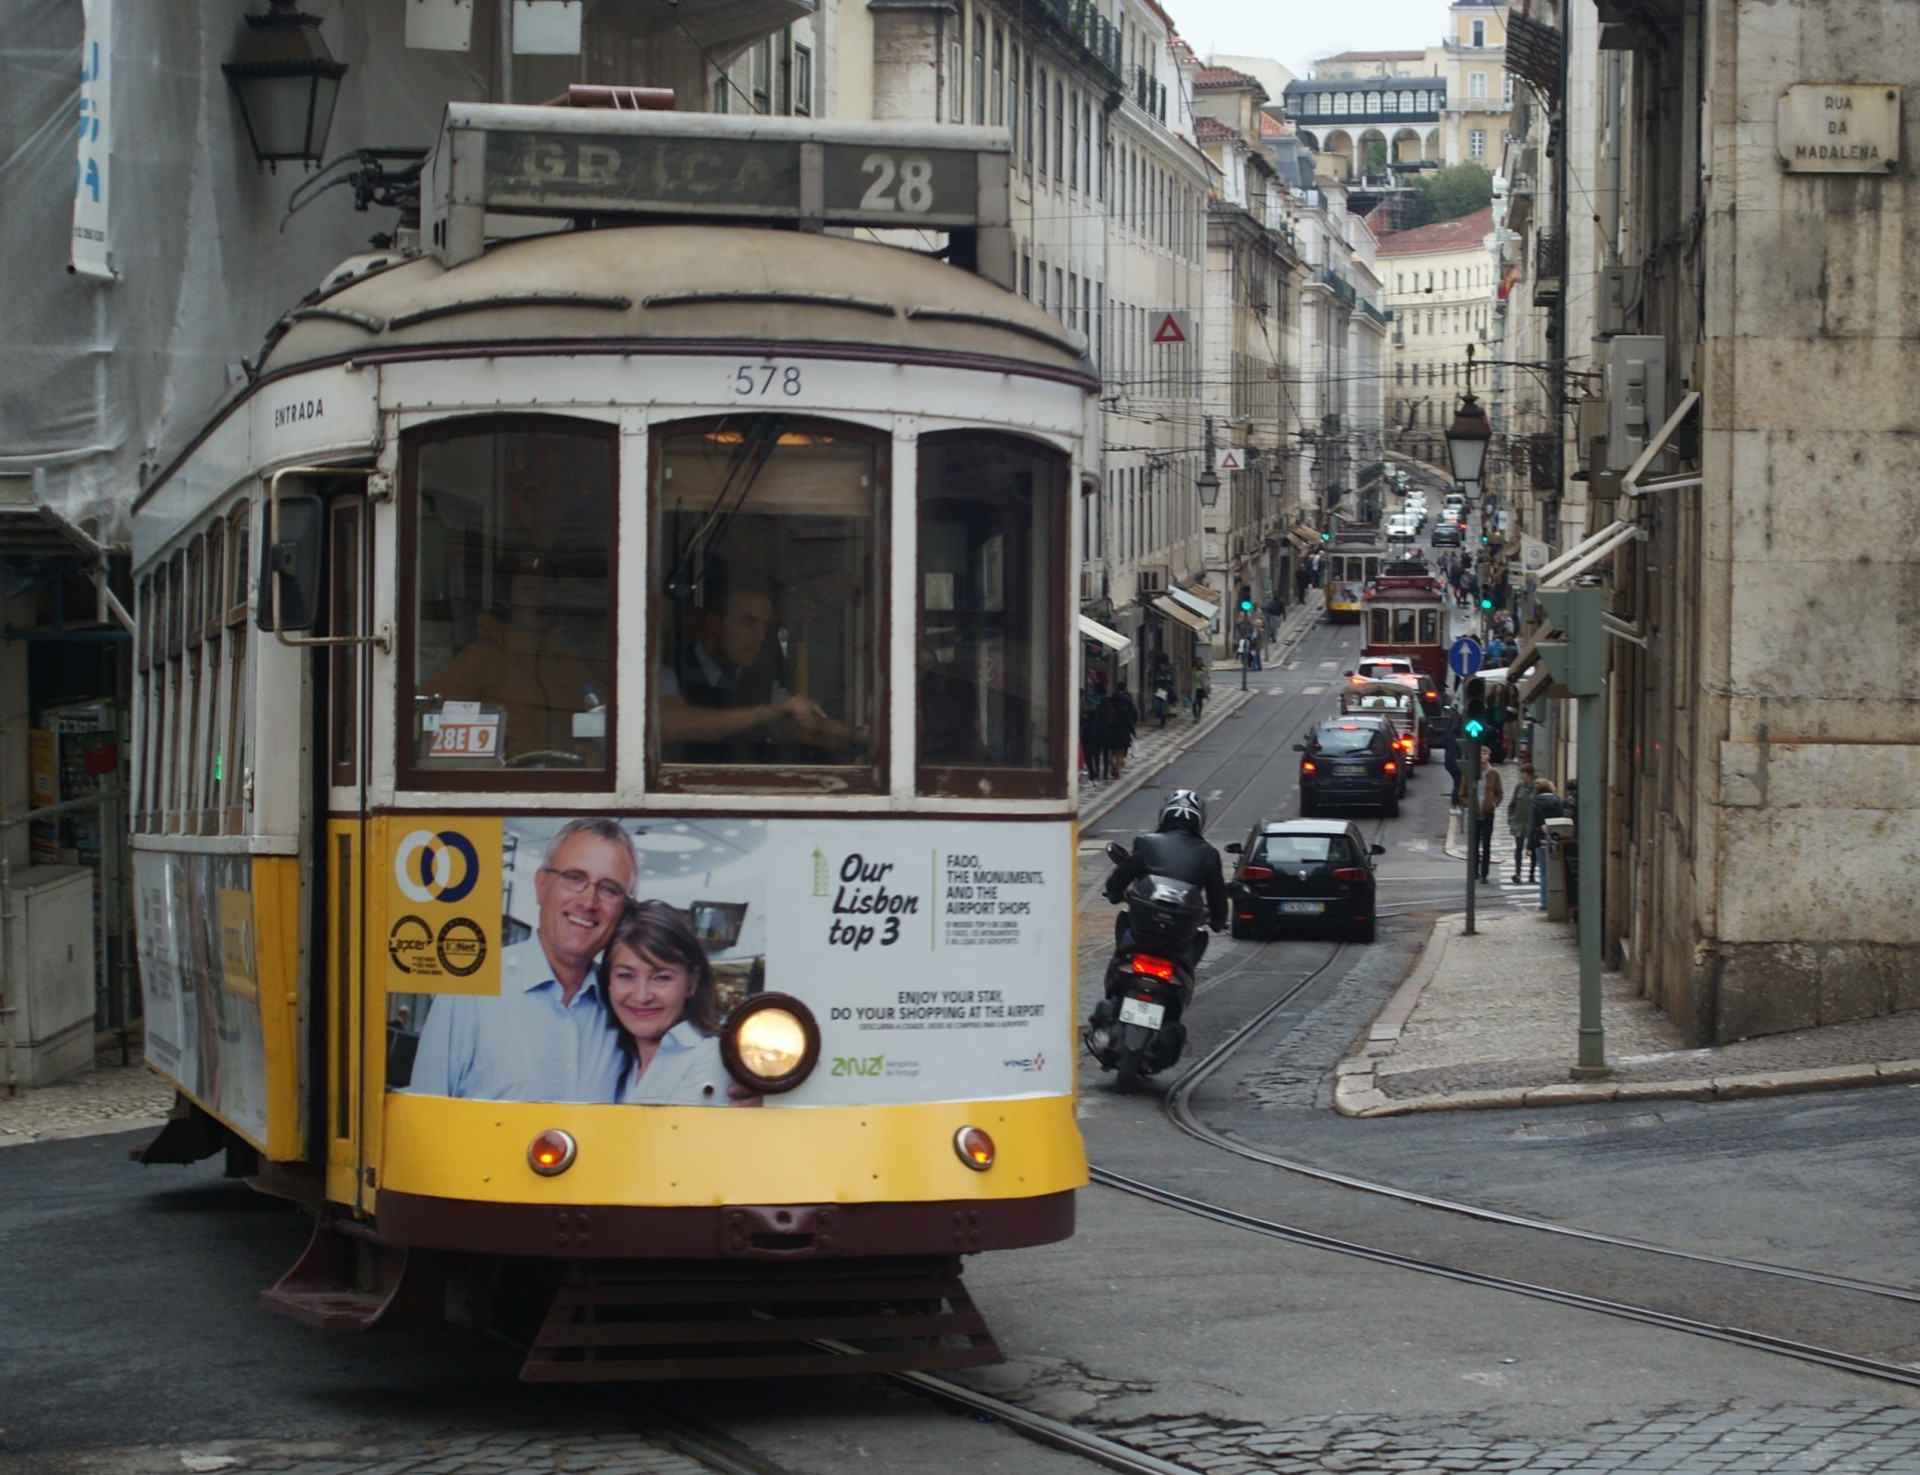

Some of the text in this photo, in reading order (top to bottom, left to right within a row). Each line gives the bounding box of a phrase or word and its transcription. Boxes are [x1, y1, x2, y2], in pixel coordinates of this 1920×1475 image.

[1825, 96, 1853, 110] RUA
[1828, 121, 1848, 134] DA
[1795, 145, 1880, 159] MADALENA
[859, 152, 933, 213] 28
[735, 365, 802, 396] 578
[275, 398, 324, 428] ENTRADA
[431, 727, 490, 750] 28E 9
[839, 853, 894, 883] Our
[946, 854, 982, 870] FADO,
[946, 870, 1046, 886] THE MONUMENTS,
[832, 885, 919, 914] Lisbon
[945, 886, 998, 899] AND THE
[945, 902, 1031, 915] AIRPORT SHOPS
[828, 916, 901, 952] top 3
[897, 991, 938, 1005] ENJOY
[941, 990, 974, 1003] YOUR
[830, 1004, 1045, 1020] DO YOUR SHOPPING AT THE AIRPORT
